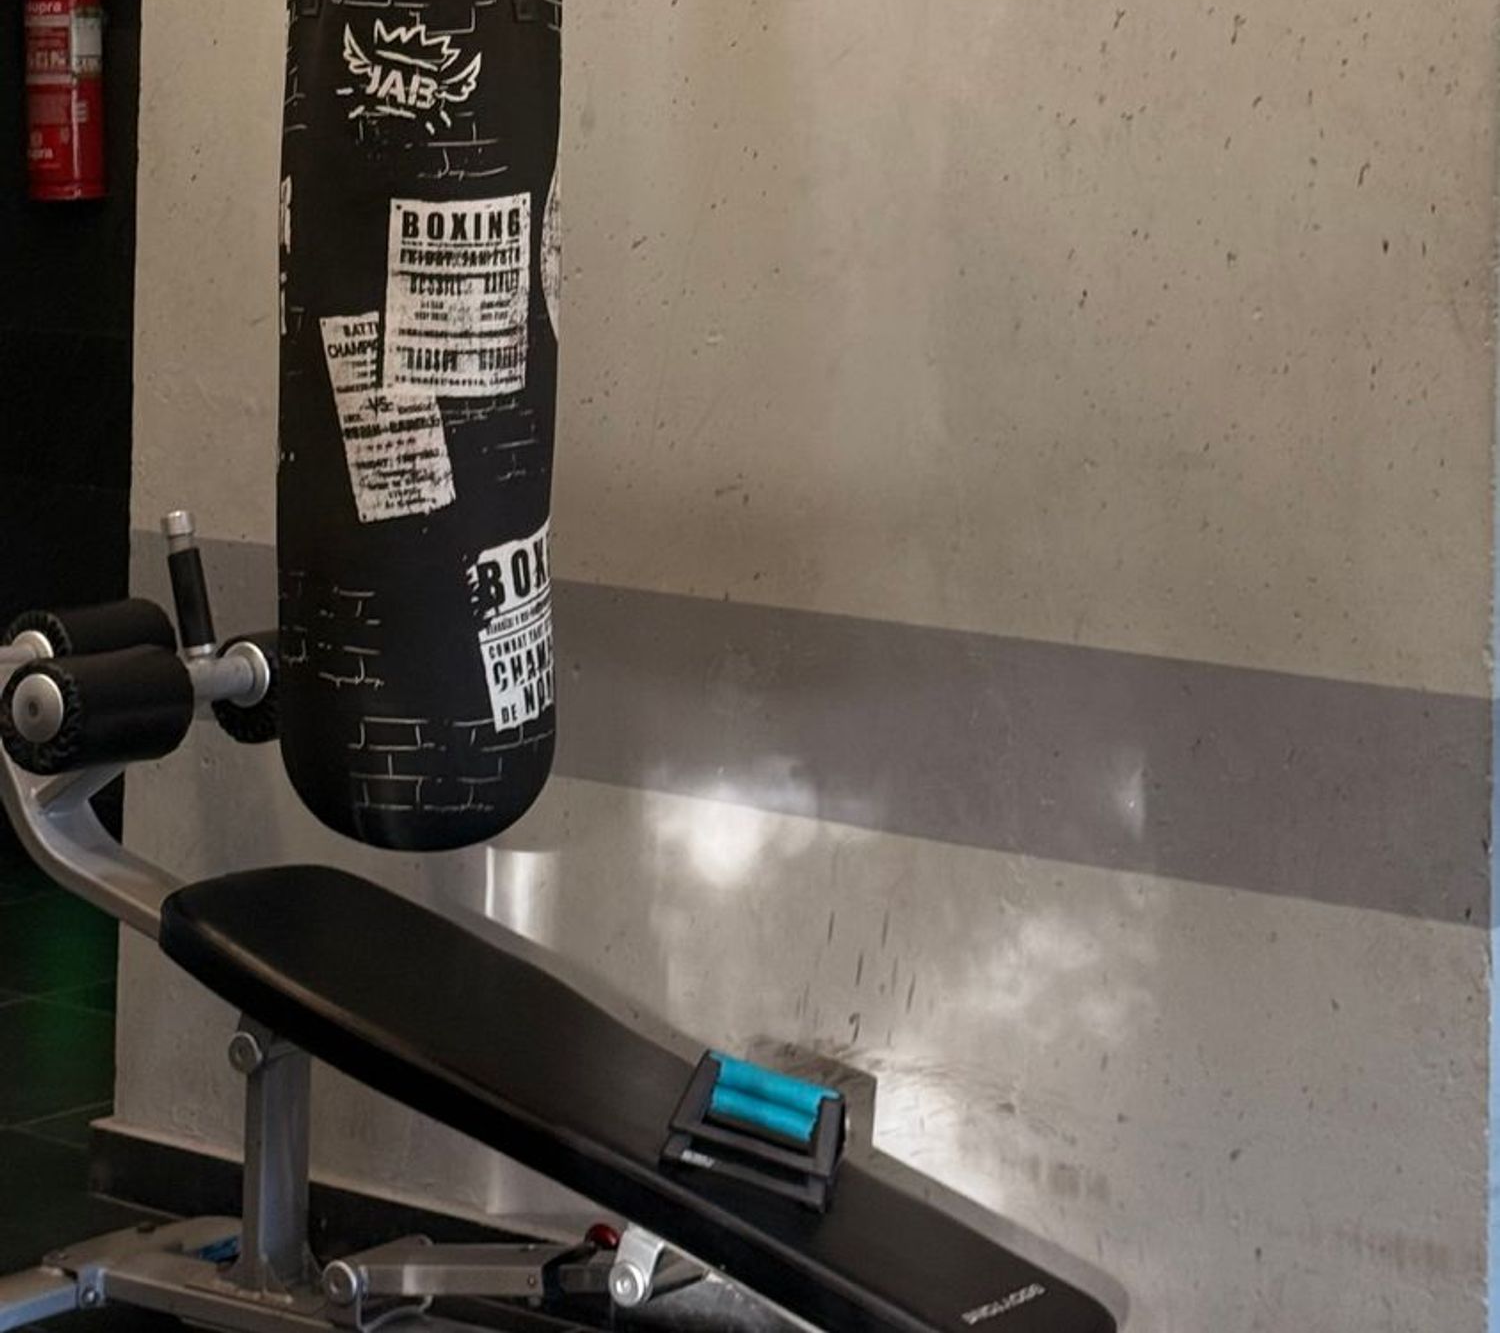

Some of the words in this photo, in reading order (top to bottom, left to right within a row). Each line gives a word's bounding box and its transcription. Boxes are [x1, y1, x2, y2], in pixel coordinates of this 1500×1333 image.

[365, 64, 439, 110] JAB
[402, 207, 521, 241] BOXING
[476, 537, 549, 607] BOX
[501, 703, 518, 725] DE
